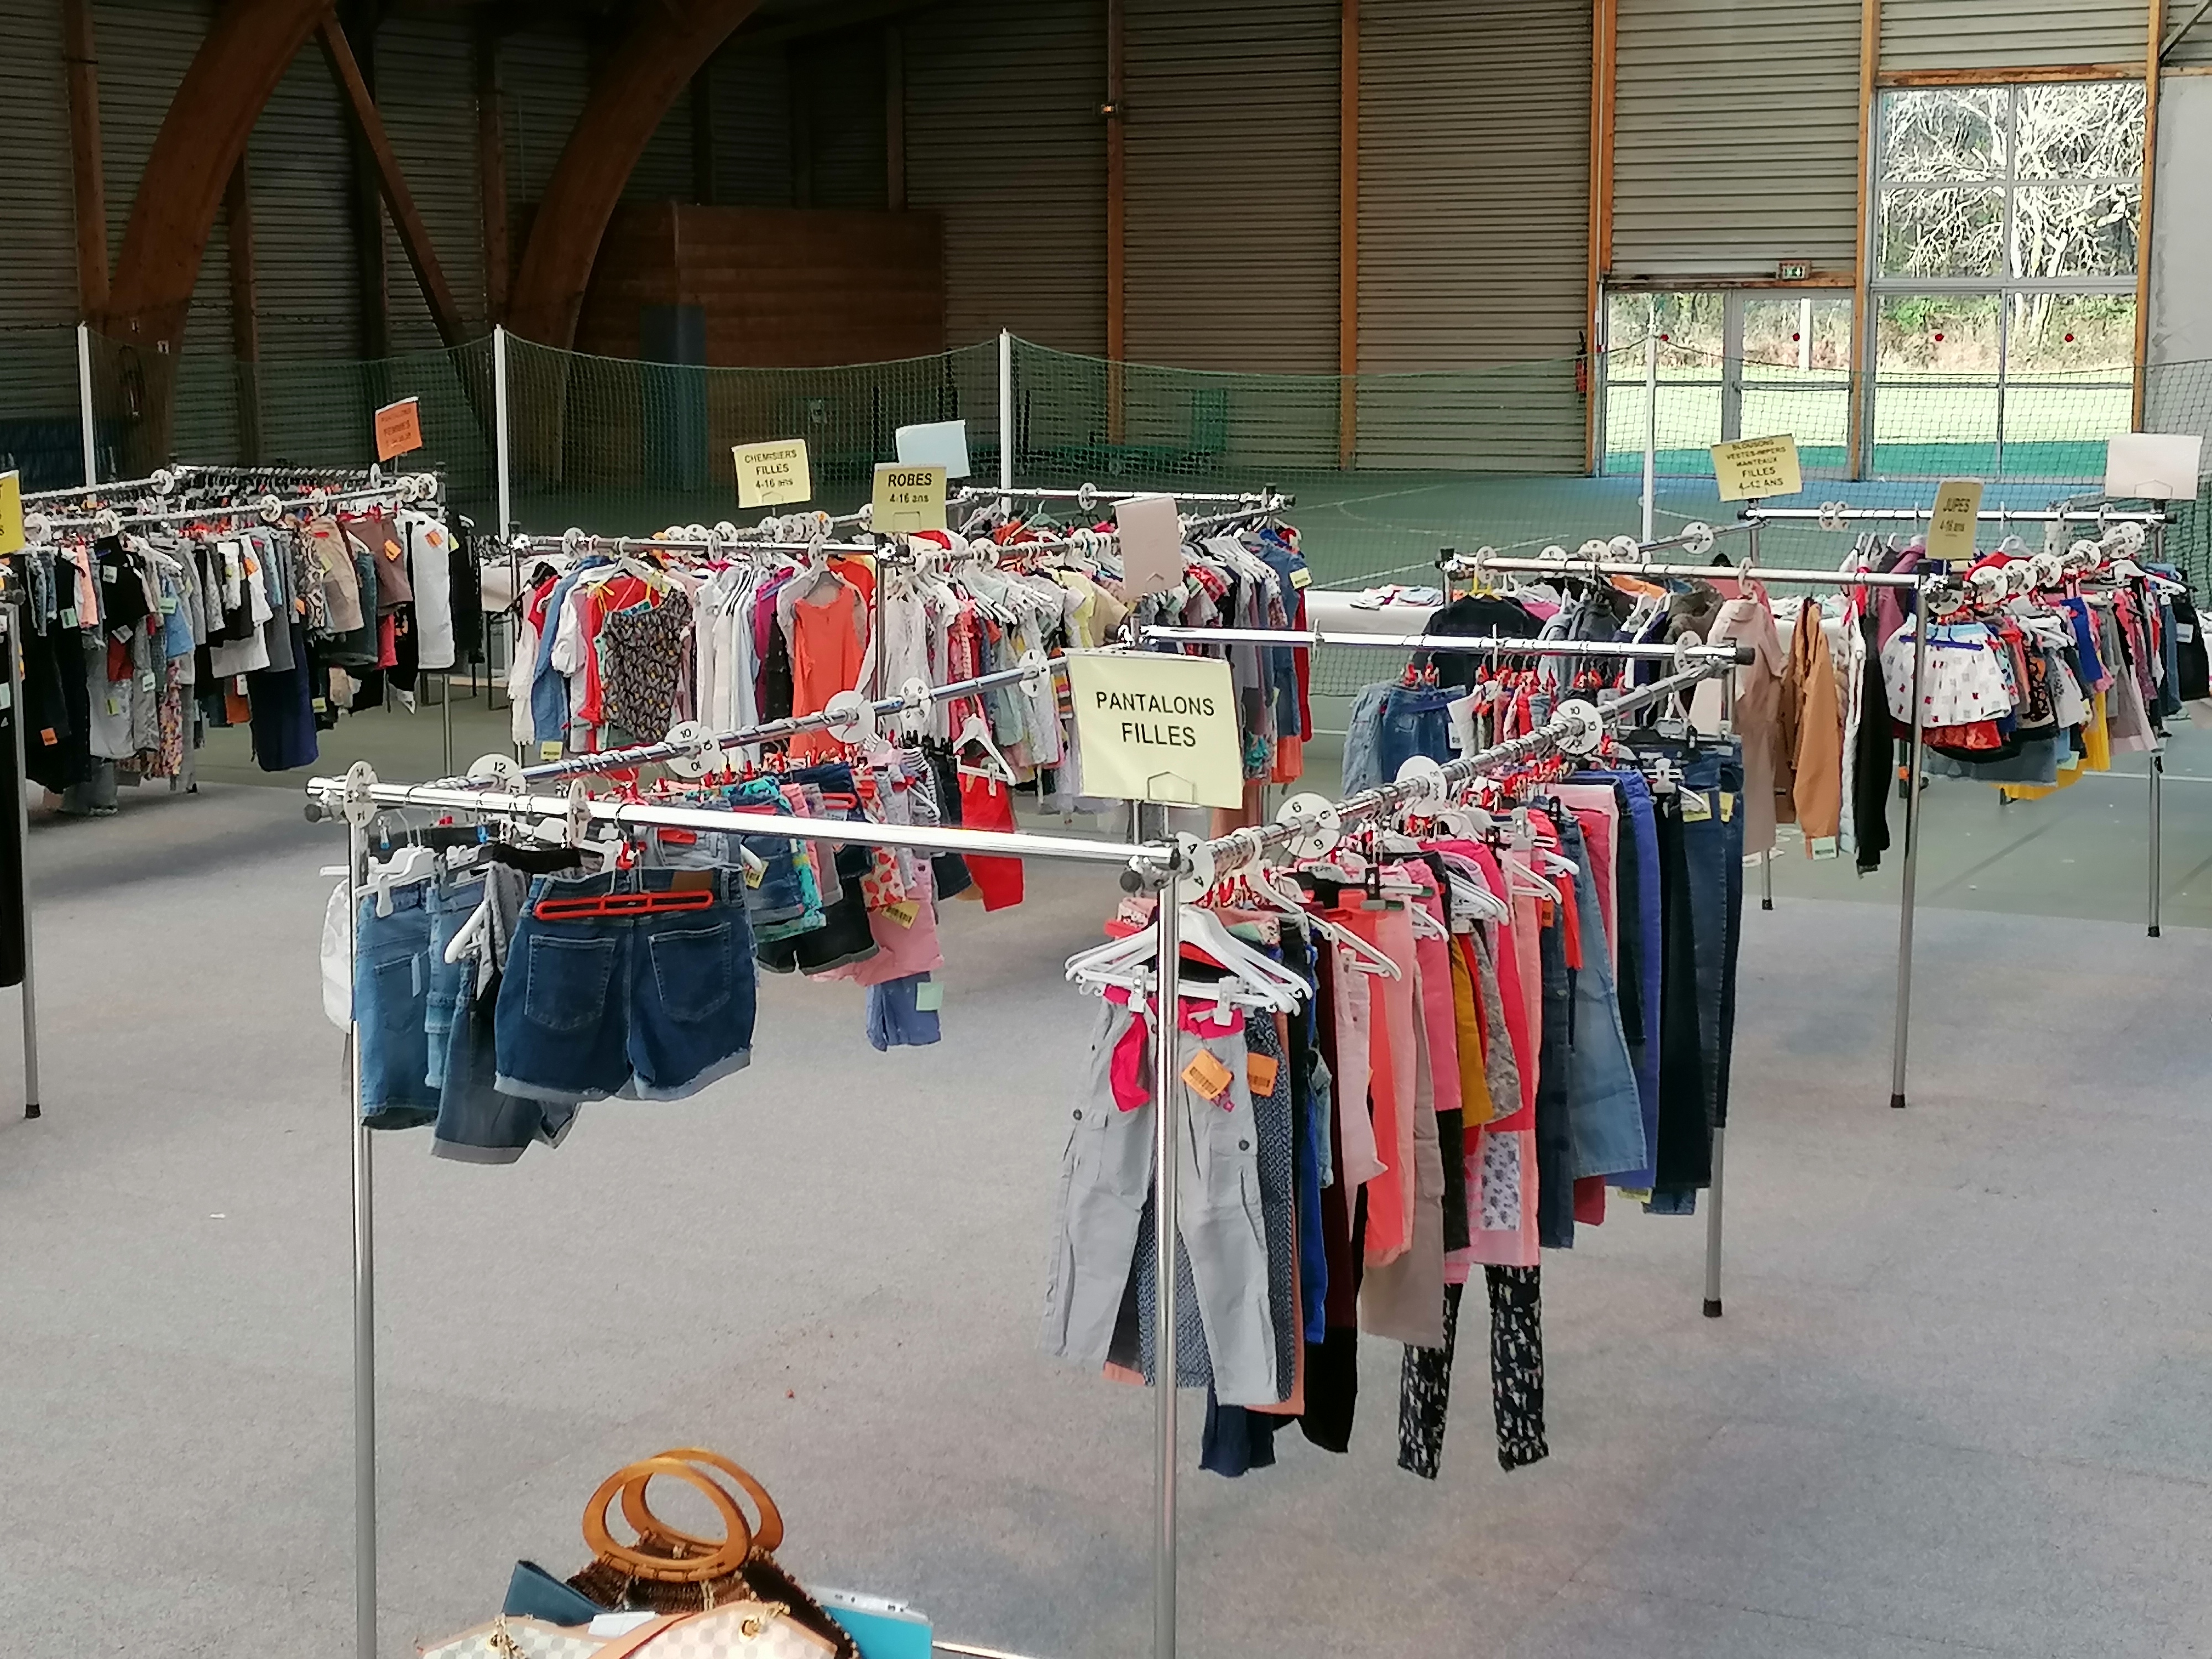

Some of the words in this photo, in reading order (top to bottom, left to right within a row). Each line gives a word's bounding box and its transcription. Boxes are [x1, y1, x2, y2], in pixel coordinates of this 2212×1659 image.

[756, 463, 790, 476] FILLES
[1742, 466, 1776, 478] FILLES
[888, 473, 932, 487] ROBES
[1764, 478, 1784, 487] ANS
[912, 494, 929, 503] ans
[1096, 691, 1215, 716] PANTALONS
[680, 728, 691, 739] 10
[1121, 722, 1197, 748] FILLES
[493, 761, 507, 774] 12
[1292, 801, 1302, 813] 6
